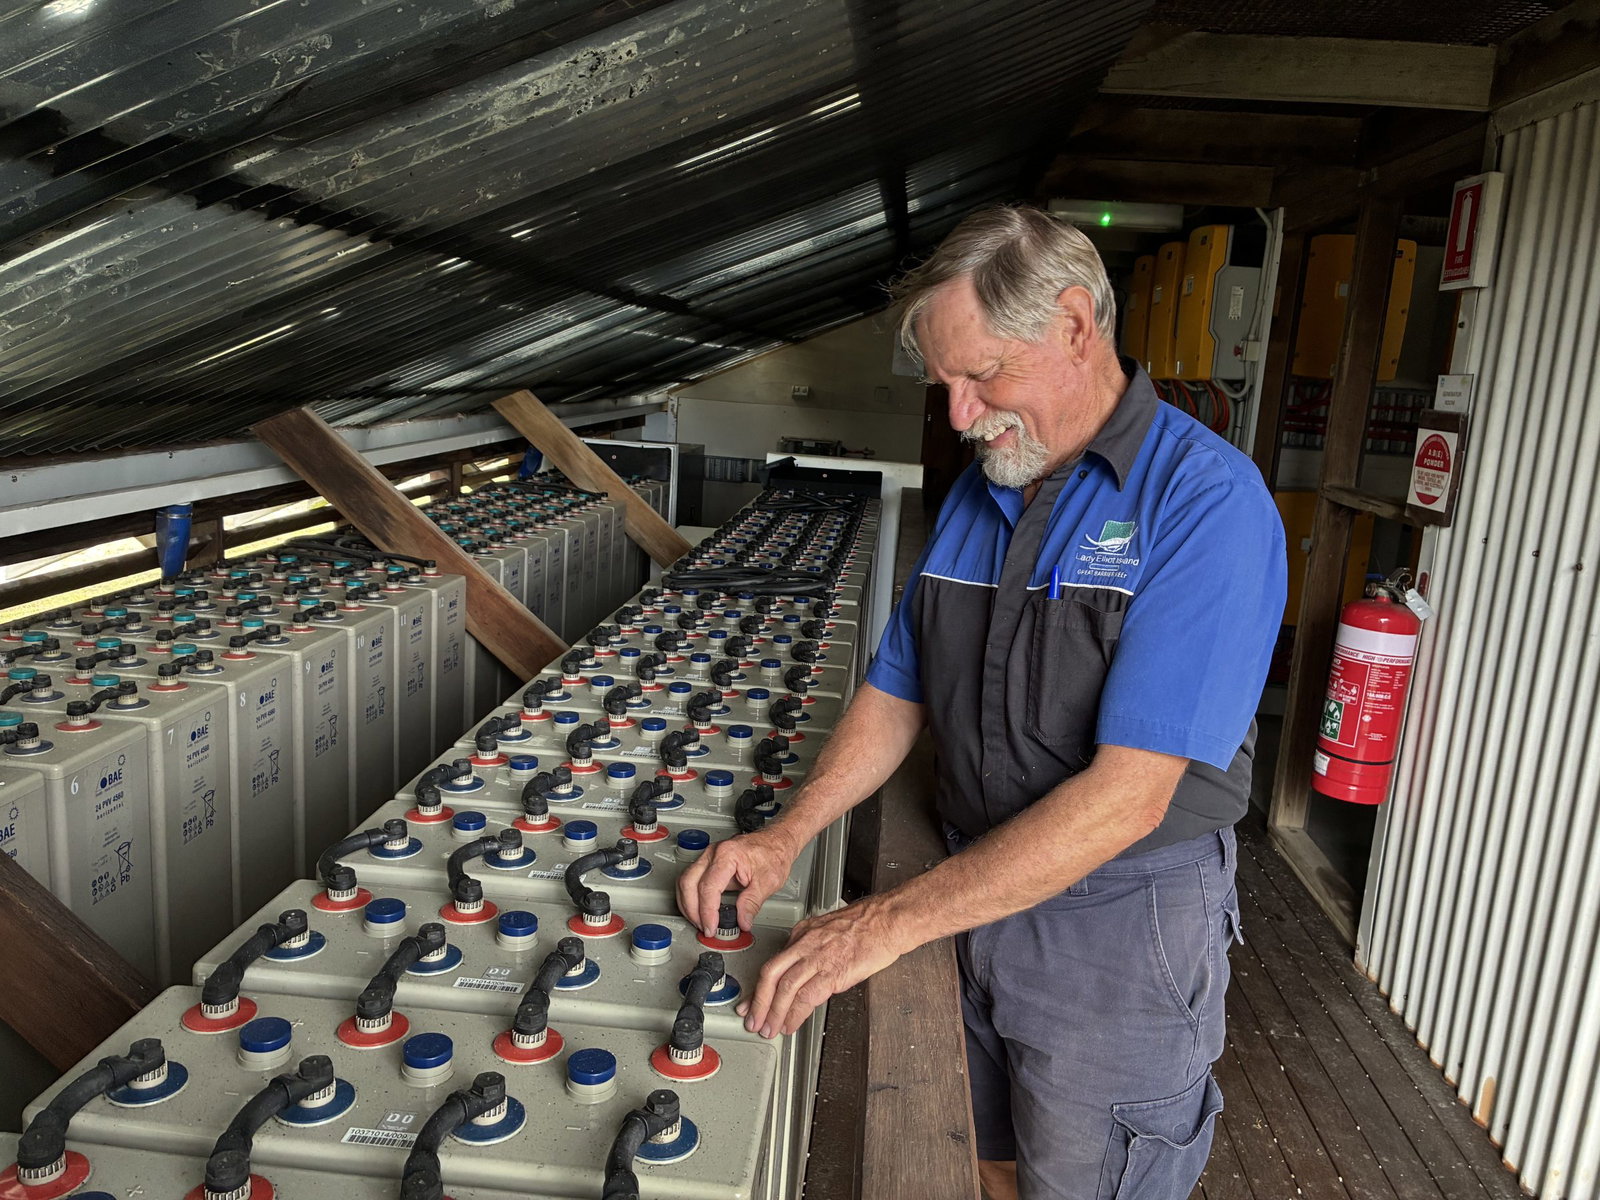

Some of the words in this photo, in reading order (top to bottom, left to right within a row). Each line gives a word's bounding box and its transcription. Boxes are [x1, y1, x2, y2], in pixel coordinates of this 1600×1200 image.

[1424, 458, 1444, 468] POWDER
[1075, 552, 1096, 563] Lady
[1096, 555, 1116, 563] Elliot
[1116, 557, 1140, 566] Island
[357, 635, 365, 649] 10
[305, 660, 311, 674] 9
[325, 660, 334, 671] BAE
[240, 692, 246, 707] 8
[264, 689, 275, 703] BAE
[167, 728, 174, 745] 7
[196, 723, 209, 739] BAE
[108, 767, 123, 786] BAE
[70, 775, 79, 795] 6
[95, 802, 102, 813] 24
[96, 801, 124, 821] horizontal
[205, 817, 214, 830] Pb
[120, 873, 131, 886] Pb
